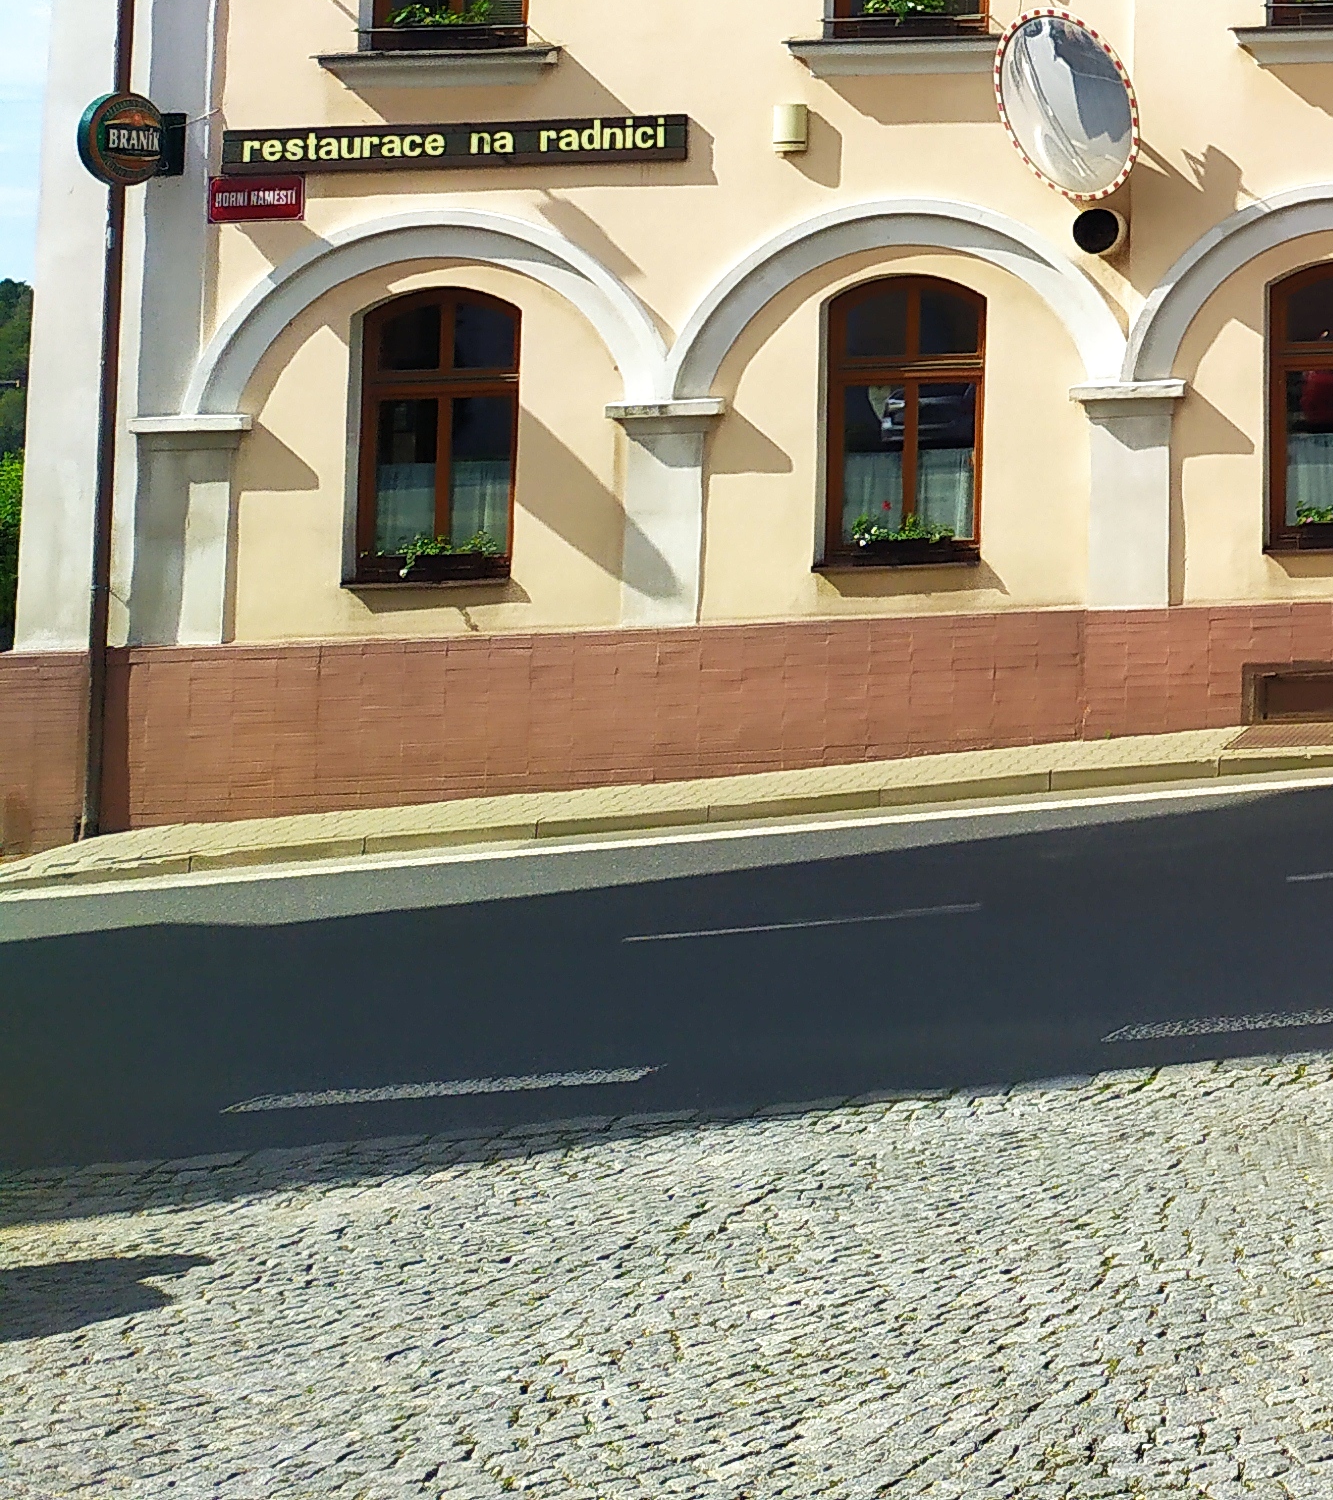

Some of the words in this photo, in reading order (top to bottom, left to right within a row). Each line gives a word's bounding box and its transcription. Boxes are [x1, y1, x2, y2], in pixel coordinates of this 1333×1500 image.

[108, 127, 161, 152] BRANÍK
[242, 132, 446, 163] restaurace
[469, 130, 514, 155] na
[539, 117, 666, 153] radnici
[214, 188, 249, 208] HORNÍ
[250, 186, 297, 206] NÁMĚSTÍ
